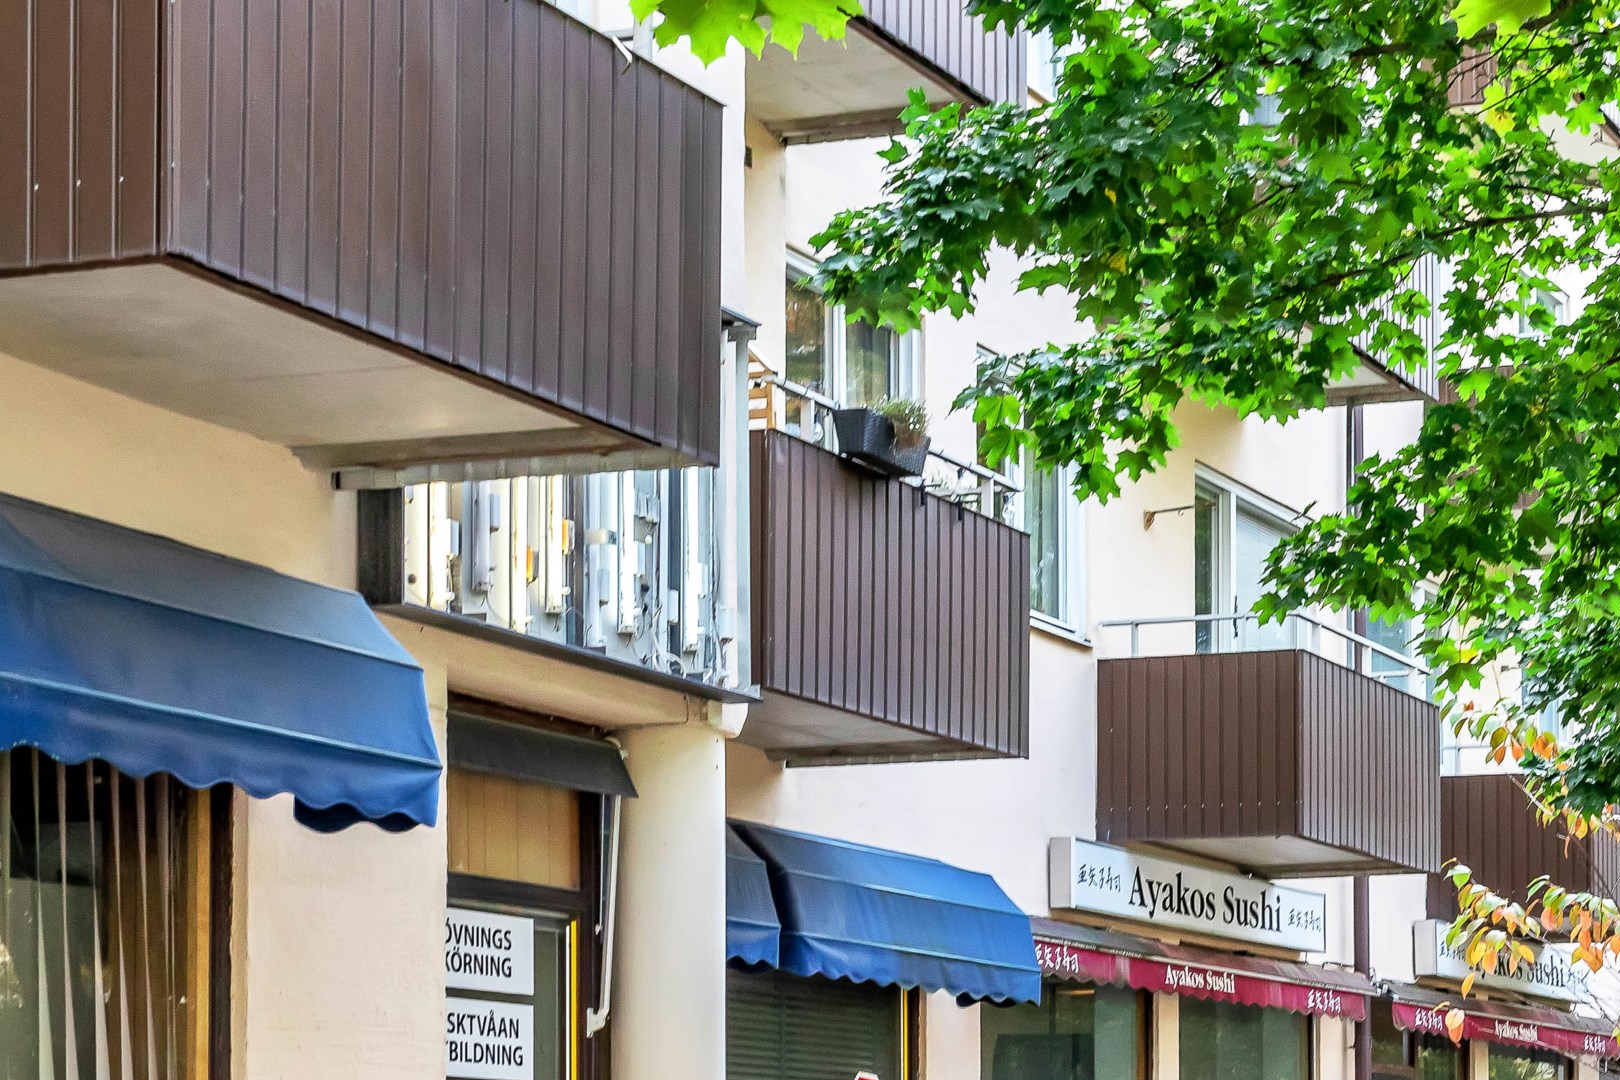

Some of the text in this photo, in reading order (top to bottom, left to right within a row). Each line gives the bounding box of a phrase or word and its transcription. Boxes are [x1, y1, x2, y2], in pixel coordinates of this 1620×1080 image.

[1129, 866, 1283, 933] Ayakos Sushi
[1165, 964, 1236, 995] Ayakos Sushi
[447, 1009, 519, 1039] SKTVÅAN
[1494, 1019, 1539, 1043] Ayakos Sushi
[446, 1040, 523, 1067] BILDNING
